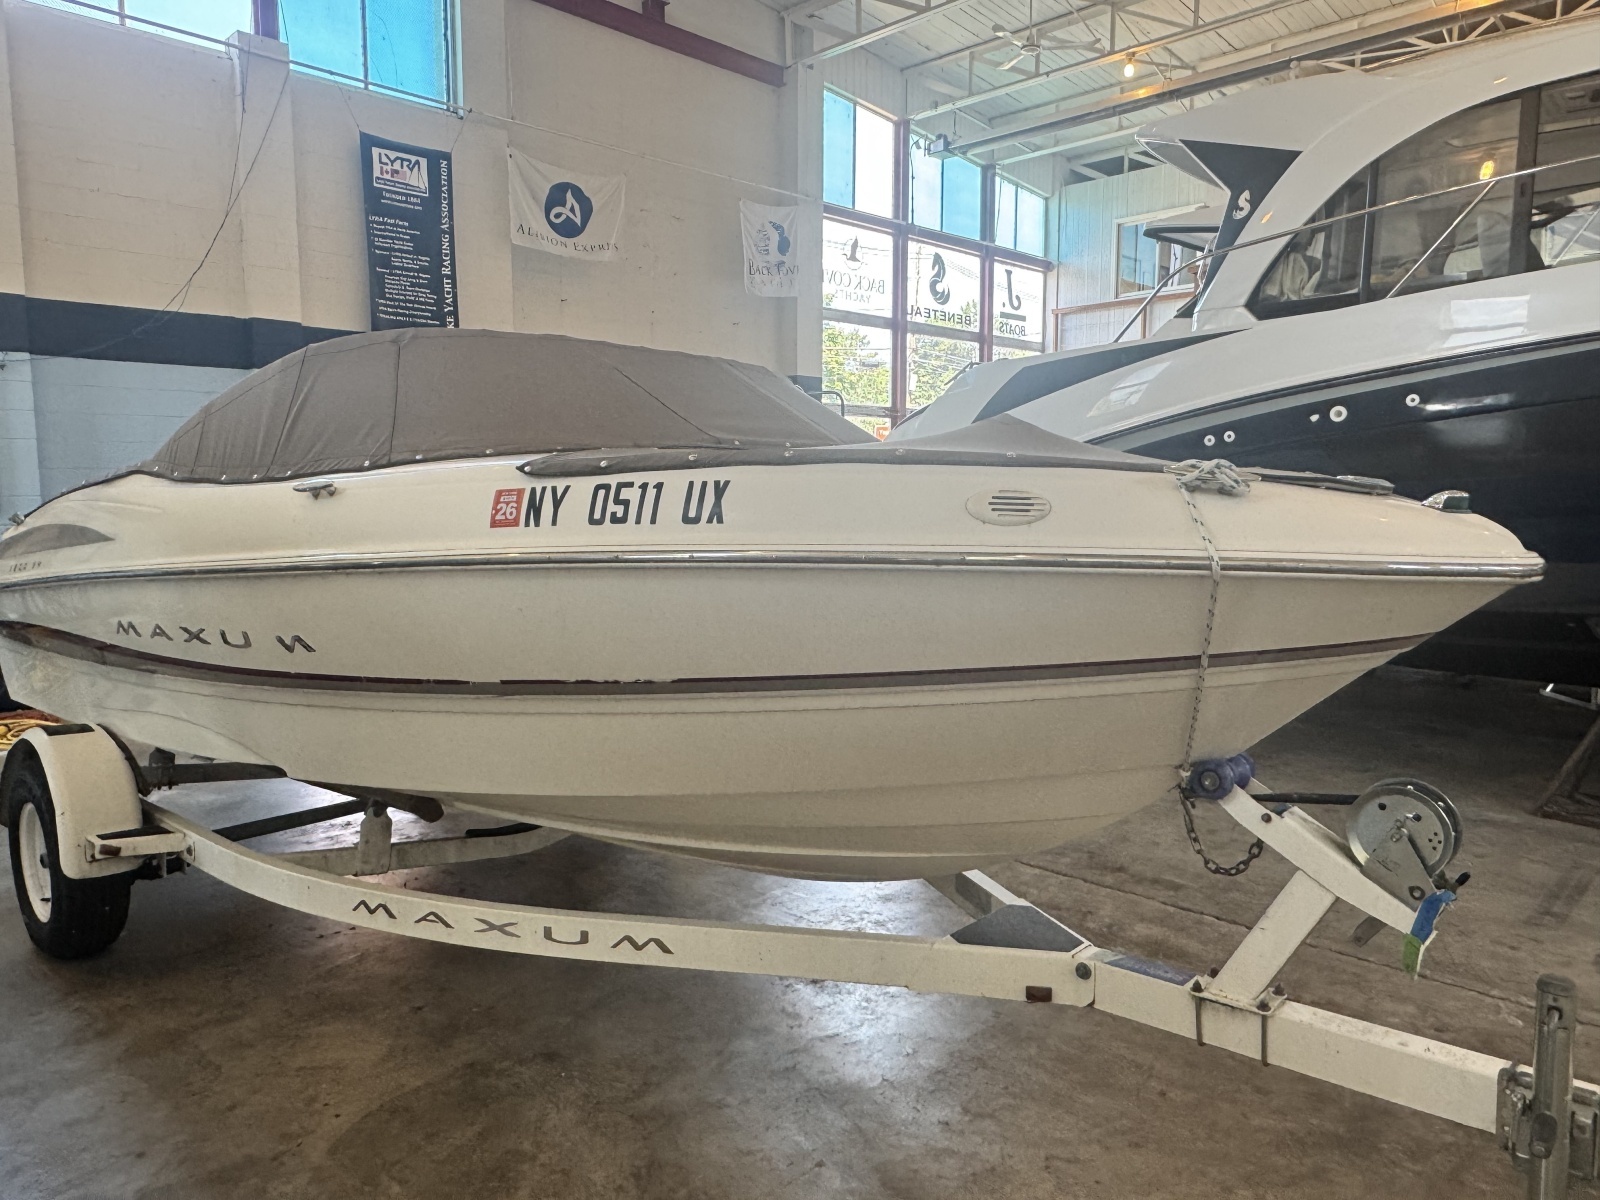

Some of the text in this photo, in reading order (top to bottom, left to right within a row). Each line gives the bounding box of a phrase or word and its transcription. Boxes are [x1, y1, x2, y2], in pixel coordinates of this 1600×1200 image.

[378, 152, 421, 172] LYRA
[440, 159, 450, 231] ASSOCIATION
[441, 234, 452, 275] RACING
[748, 258, 774, 276] BACK
[443, 277, 454, 313] YACHT
[494, 502, 518, 520] 26
[524, 480, 731, 528] NY 0511 UX
[352, 899, 675, 955] MAXUM
